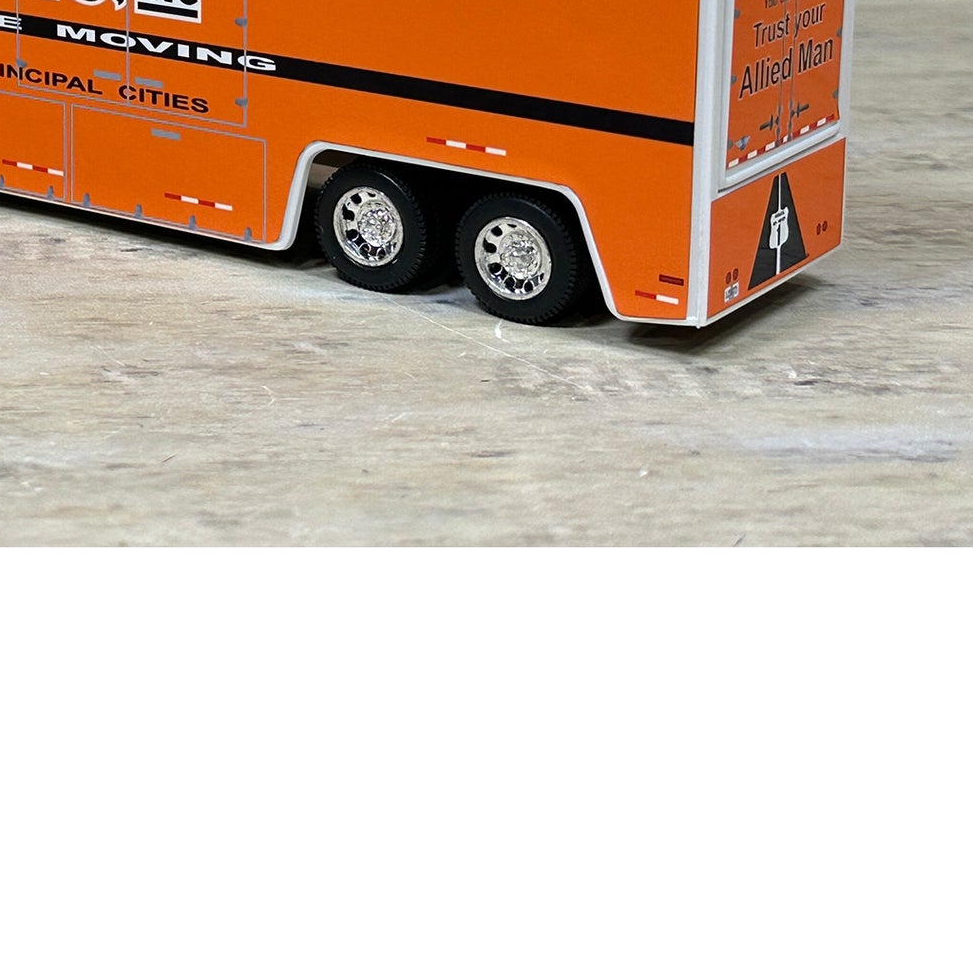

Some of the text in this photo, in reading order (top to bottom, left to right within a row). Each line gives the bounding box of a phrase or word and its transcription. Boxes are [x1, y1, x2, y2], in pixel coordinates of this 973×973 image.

[56, 24, 277, 72] MOVING
[753, 3, 826, 48] Trust your
[738, 38, 833, 100] Allied Man
[118, 84, 210, 114] CITIES
